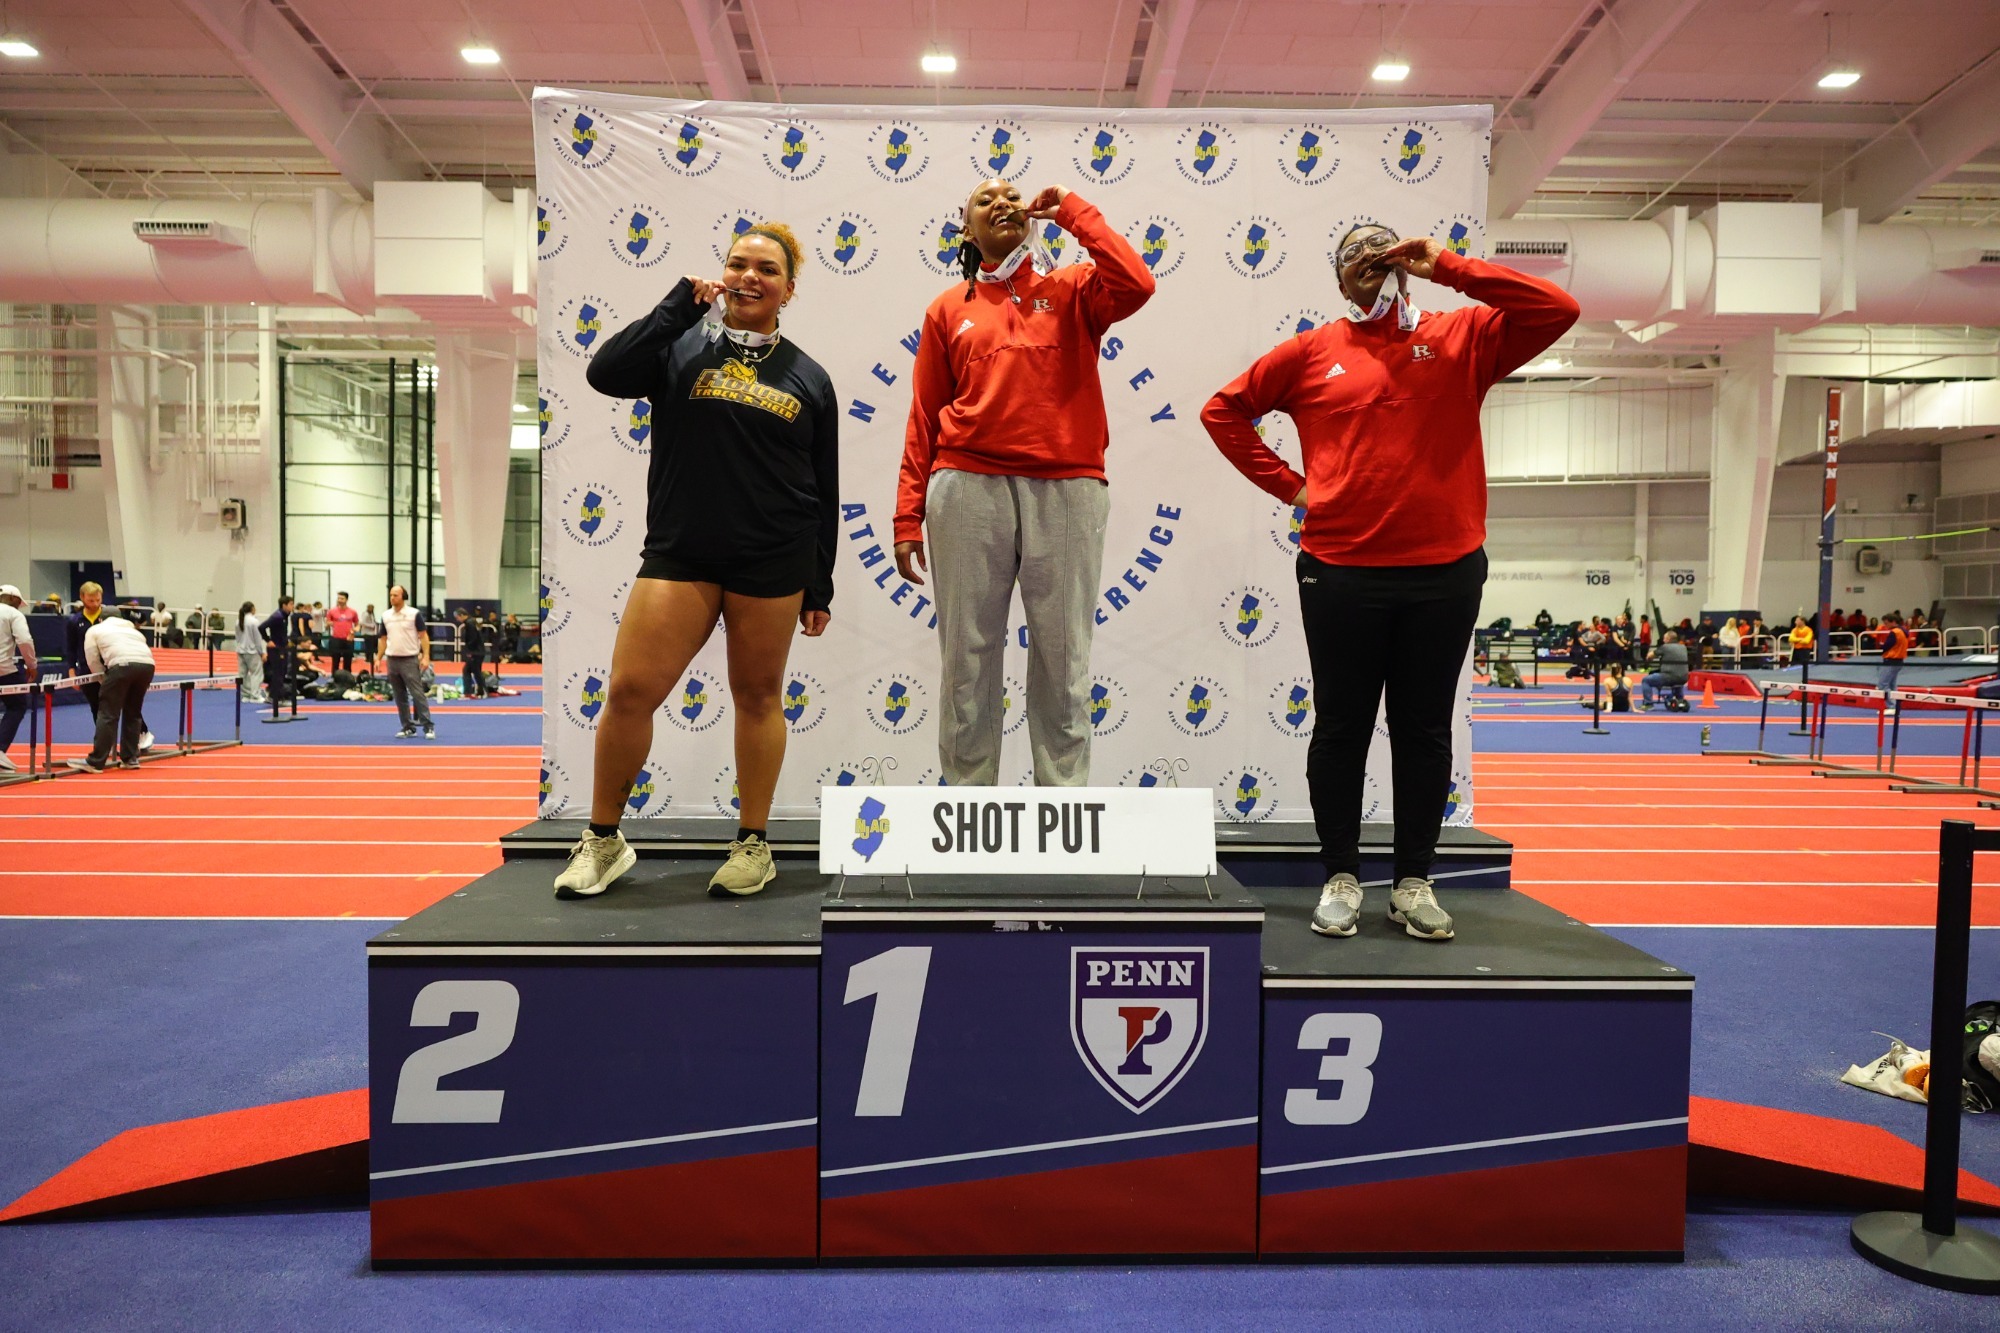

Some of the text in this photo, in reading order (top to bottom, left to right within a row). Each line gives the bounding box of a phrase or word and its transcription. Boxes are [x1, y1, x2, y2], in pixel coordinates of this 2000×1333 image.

[552, 103, 615, 131] NEW JERSEY
[658, 112, 721, 139] NEW JERSEY
[572, 128, 598, 143] NJAC
[763, 116, 825, 143] NEW JERSEY
[867, 118, 929, 143] NEW JERSEY
[971, 118, 1032, 143] NEW JERSEY
[1073, 121, 1134, 146] NEW JERSEY
[1176, 121, 1237, 145] NEW JERSEY
[1279, 122, 1340, 146] NEW JERSEY
[1382, 119, 1443, 145] NEW JERSEY
[552, 137, 617, 170] ATHLETIC CONFERENCE
[678, 137, 703, 152] NJAC
[782, 142, 808, 157] NJAC
[886, 143, 912, 158] NJAC
[989, 143, 1014, 158] NJAC
[1092, 145, 1116, 160] NJAC
[1194, 146, 1220, 161] NJAC
[1298, 146, 1322, 161] NJAC
[1400, 144, 1426, 159] NJAC
[657, 147, 722, 178] ATHLETIC CONFERENCE
[762, 153, 827, 182] ATHLETIC CONFERENCE
[866, 155, 930, 184] ATHLETIC CONFERENCE
[1071, 157, 1136, 186] ATHLETIC CONFERENCE
[1174, 157, 1238, 186] ATHLETIC CONFERENCE
[1277, 158, 1341, 187] ATHLETIC CONFERENCE
[1380, 157, 1406, 185] ATHLETIC
[1407, 155, 1443, 185] CONFERENCE
[608, 202, 670, 229] NEW JERSEY
[713, 213, 728, 230] NEW
[816, 211, 878, 236] NEW JERSEY
[920, 218, 935, 235] NEW
[1125, 215, 1184, 238] NEW JERSEY
[1226, 214, 1287, 239] NEW JERSEY
[628, 228, 653, 243] NJAC
[1329, 220, 1343, 238] NEW
[1430, 219, 1444, 237] NEW
[607, 238, 672, 269] ATHLETIC CONFERENCE
[836, 235, 860, 250] NJAC
[1143, 239, 1167, 253] NJAC
[1244, 239, 1270, 254] NJAC
[1447, 238, 1470, 253] NJAC
[815, 247, 879, 276] ATHLETIC CONFERENCE
[919, 249, 942, 275] ATHLETIC
[1224, 251, 1288, 280] ATHLETIC CONFERENCE
[558, 295, 618, 320] NEW JERSEY
[1033, 299, 1050, 309] R
[577, 319, 601, 334] NJAC
[1276, 314, 1290, 331] NEW
[556, 330, 580, 357] ATHLETIC
[1413, 345, 1430, 357] R
[696, 389, 738, 399] TRACK
[760, 401, 793, 419] FIELD
[611, 426, 634, 453] ATHLETIC
[1826, 419, 1839, 479] PENN
[562, 482, 623, 507] NEW JERSEY
[580, 507, 604, 522] NJAC
[561, 518, 624, 547] ATHLETIC CONFERENCE
[1270, 529, 1293, 556] ATHLETIC
[1511, 572, 1543, 581] AREA
[1585, 574, 1611, 585] 108
[1669, 574, 1695, 586] 109
[613, 581, 628, 599] NEW
[1220, 585, 1279, 609] NEW JERSEY
[1238, 609, 1262, 624] NJAC
[1218, 620, 1280, 649] ATHLETIC CONFERENCE
[74, 676, 90, 685] PENN
[563, 672, 578, 690] NEW
[688, 666, 725, 694] JERSEY
[790, 671, 826, 695] JERSEY
[867, 673, 927, 697] NEW JERSEY
[1093, 675, 1128, 698] JERSEY
[1169, 675, 1228, 699] NEW JERSEY
[1269, 682, 1284, 699] NEW
[582, 691, 606, 706] NJAC
[682, 693, 708, 708] NJAC
[784, 694, 809, 709] NJAC
[886, 696, 910, 711] NJAC
[1186, 698, 1212, 714] NJAC
[1287, 700, 1312, 714] NJAC
[562, 703, 585, 729] ATHLETIC
[662, 705, 726, 733] ATHLETIC CONFERENCE
[791, 706, 827, 734] CONFERENCE
[865, 708, 929, 735] ATHLETIC CONFERENCE
[1093, 710, 1129, 737] CONFERENCE
[1167, 710, 1230, 738] ATHLETIC CONFERENCE
[1268, 711, 1291, 736] ATHLETIC
[714, 765, 730, 783] NEW
[816, 766, 831, 784] NEW
[917, 768, 933, 785] NEW
[1018, 769, 1033, 786] NEW
[1118, 769, 1133, 786] NEW
[1218, 762, 1278, 788] NEW JERSEY
[1236, 787, 1262, 802] NJAC
[1217, 799, 1242, 826] ATHLETIC
[854, 817, 890, 840] NJAC
[932, 801, 1105, 854] SHOT PUT
[1086, 961, 1195, 987] PENN
[843, 946, 932, 1117] 1
[1117, 1007, 1172, 1076] P
[391, 980, 520, 1124] 2
[1284, 1012, 1383, 1125] 3
